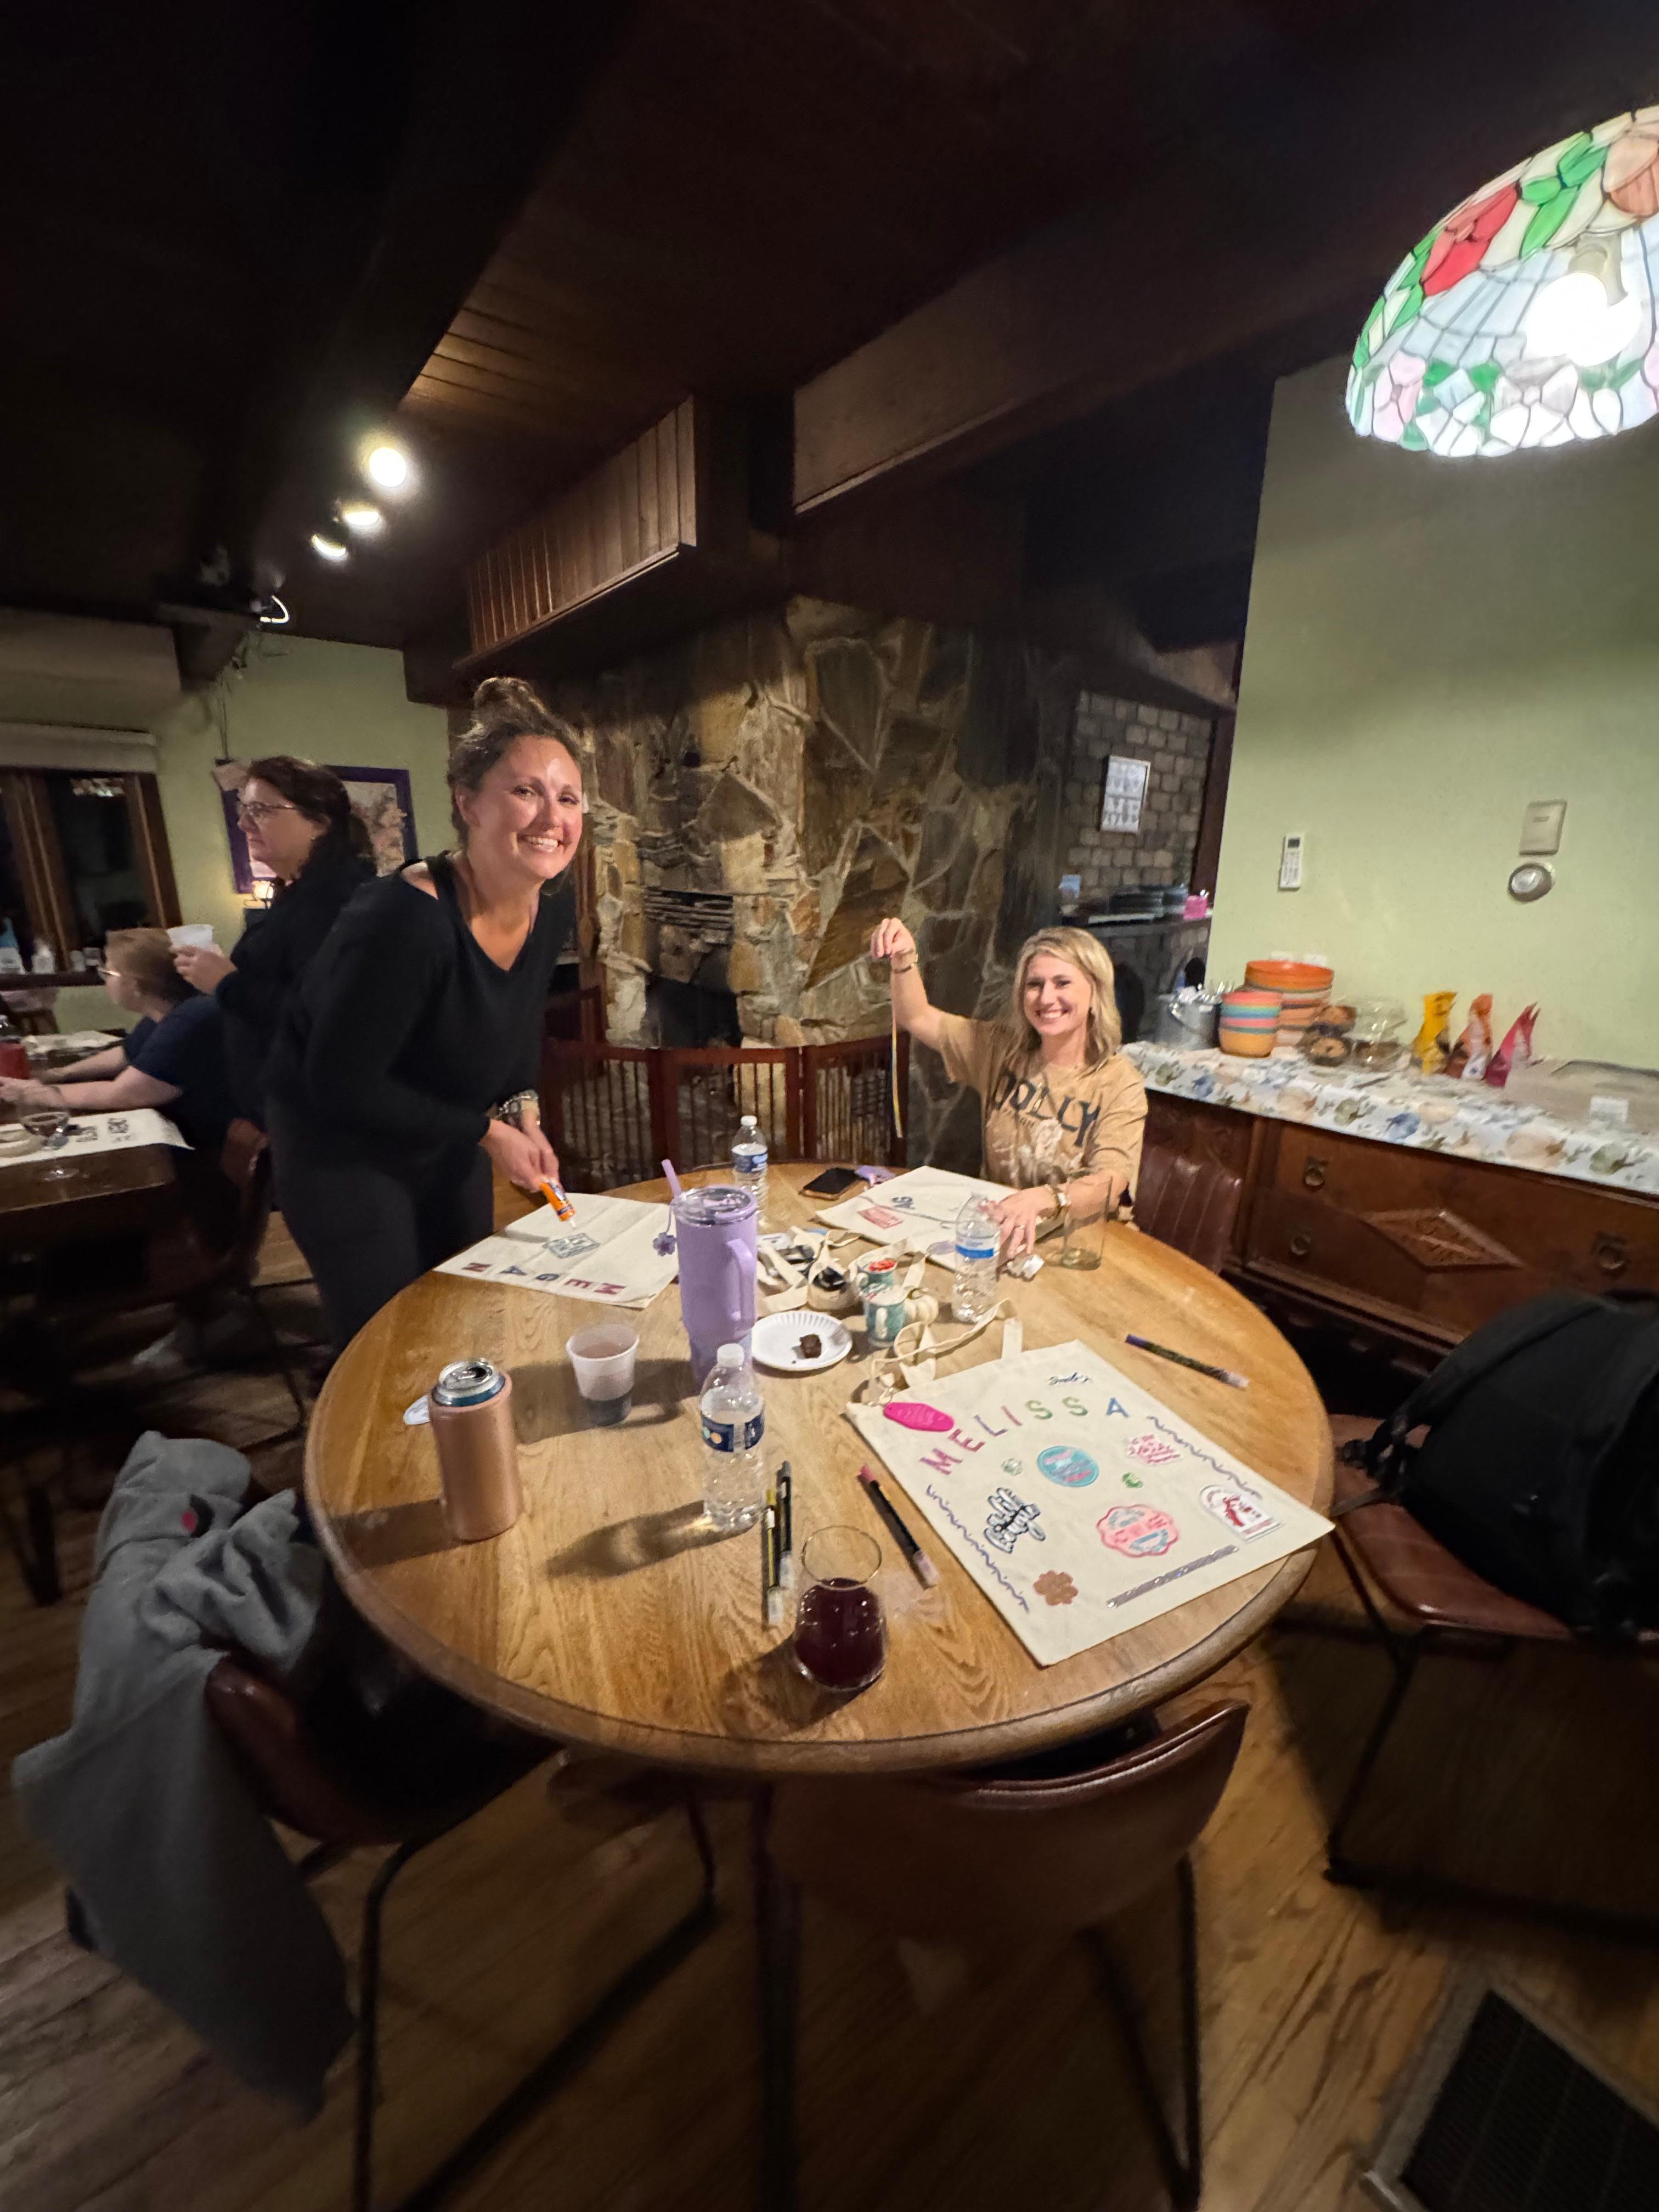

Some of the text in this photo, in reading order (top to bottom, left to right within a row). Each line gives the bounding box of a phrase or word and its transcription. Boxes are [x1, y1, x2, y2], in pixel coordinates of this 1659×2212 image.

[994, 1067, 1102, 1147] DOLLY
[461, 1262, 627, 1295] MEGAN
[918, 1396, 1131, 1476] MELISSA
